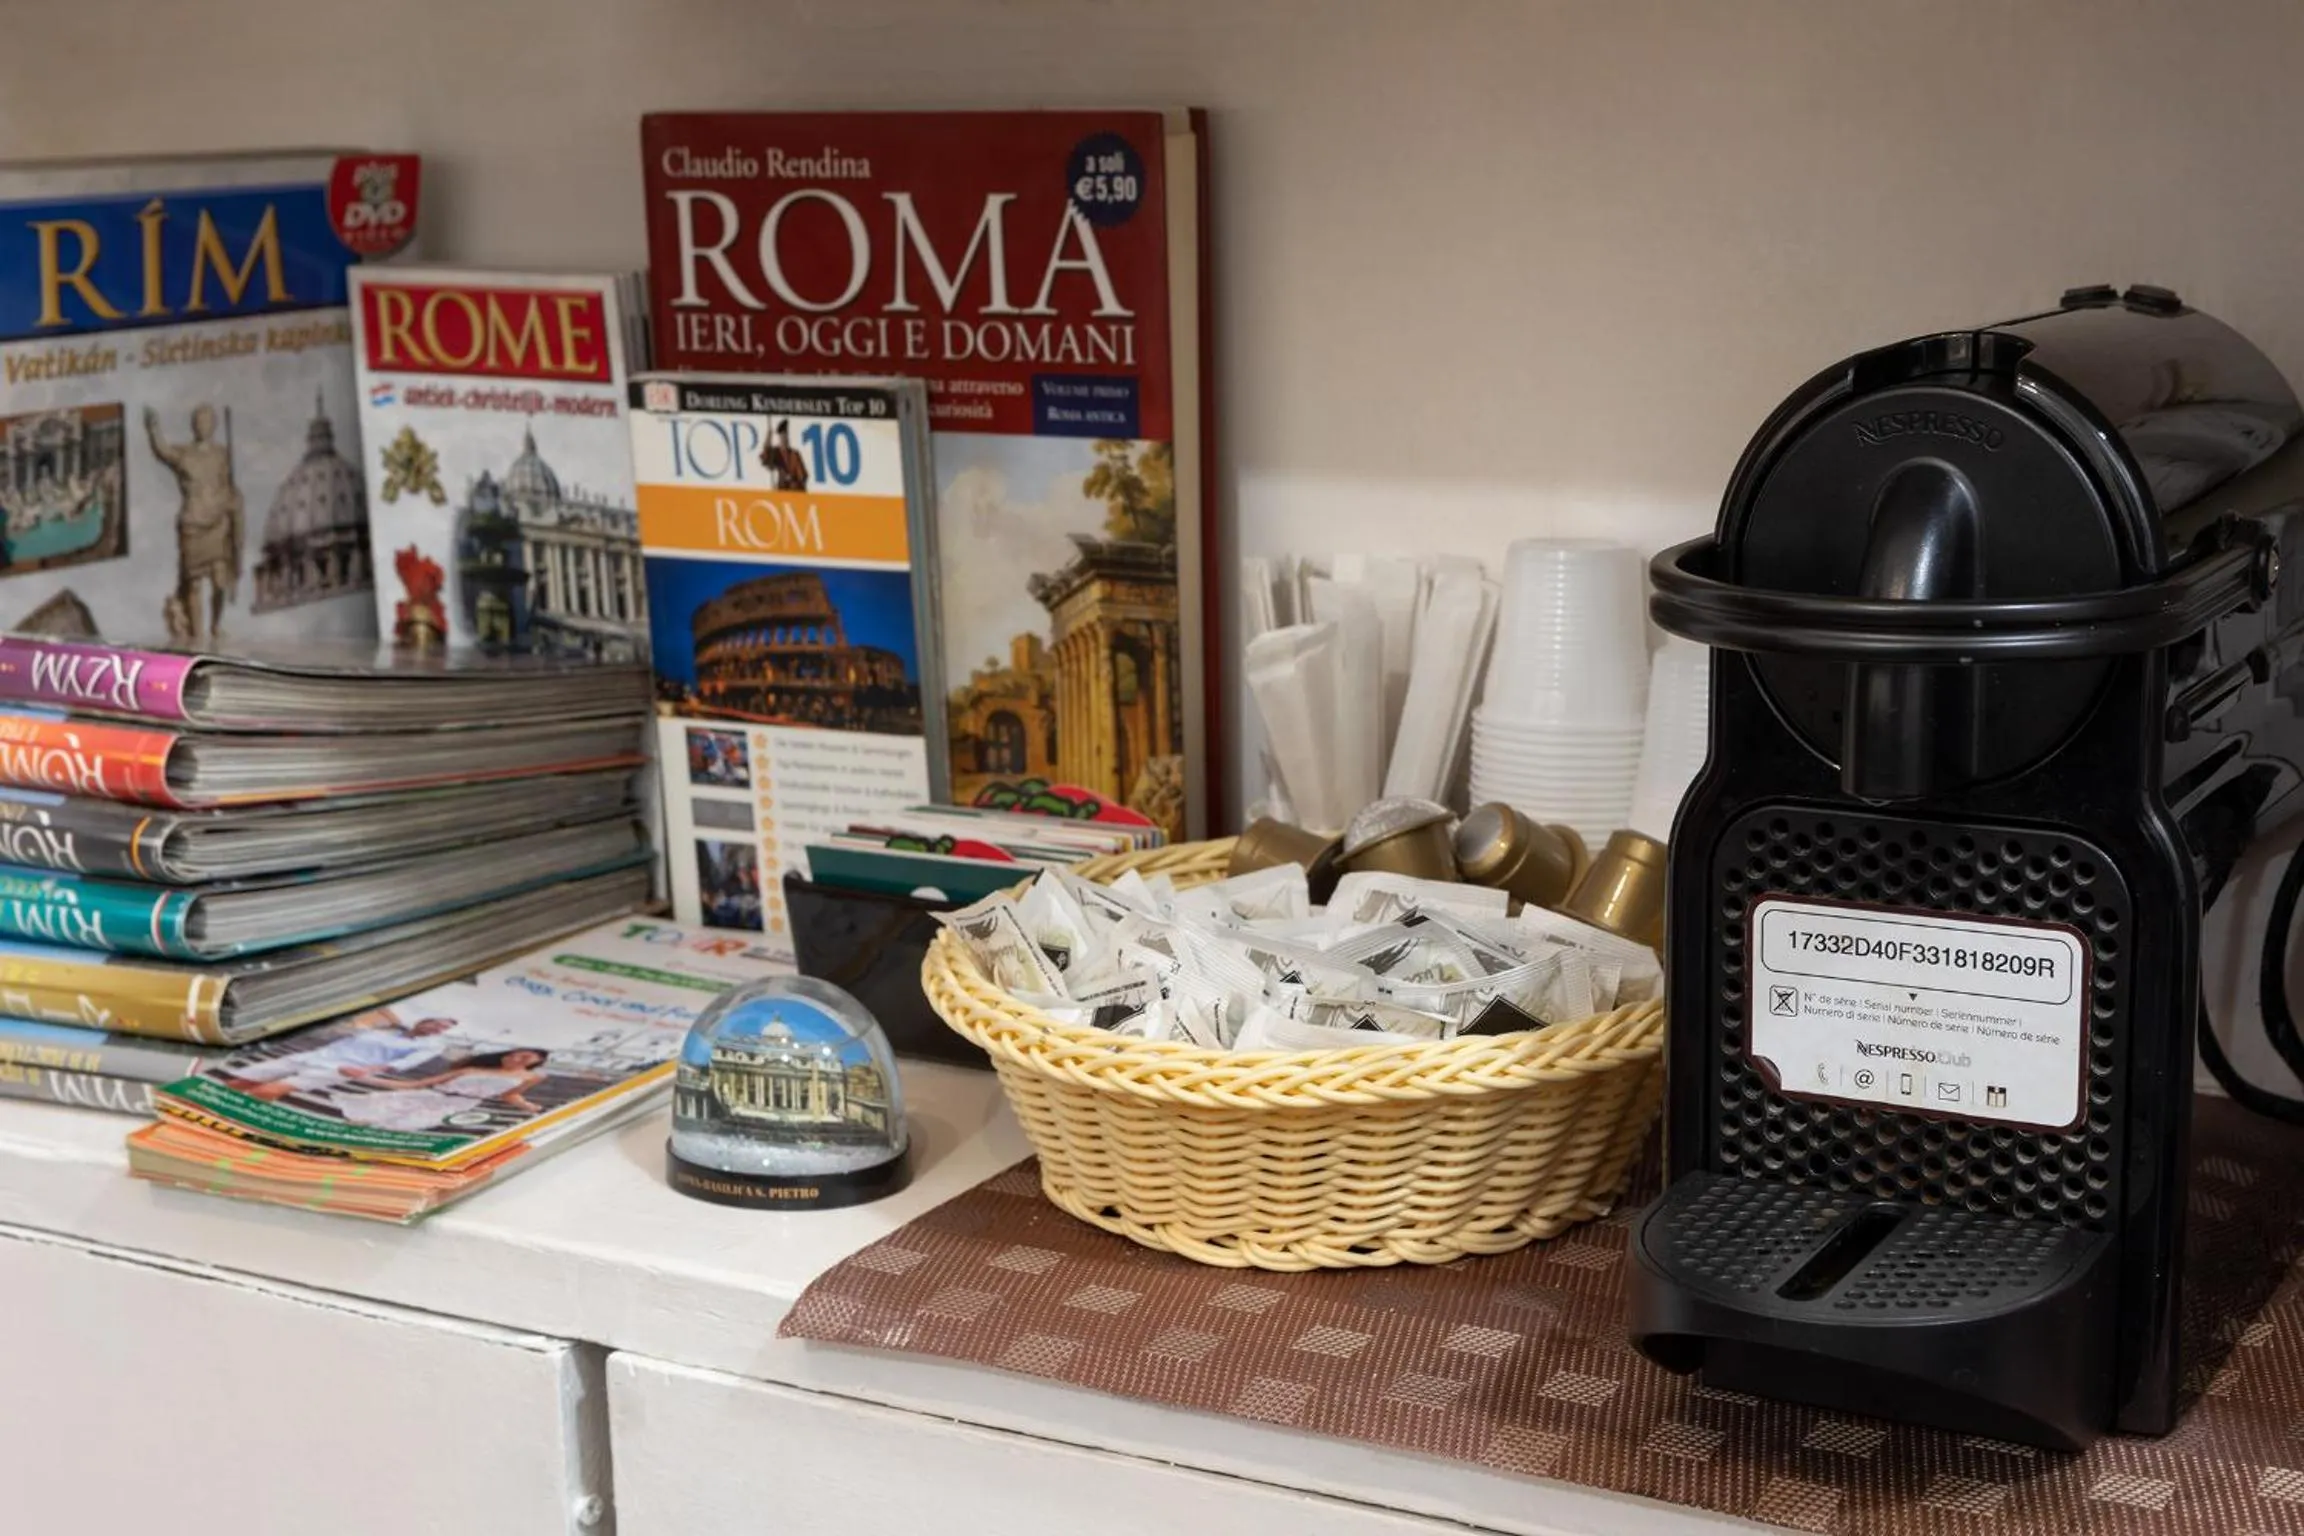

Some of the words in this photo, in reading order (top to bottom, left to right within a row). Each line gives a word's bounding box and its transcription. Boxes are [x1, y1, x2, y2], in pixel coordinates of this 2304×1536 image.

[661, 146, 759, 179] Claudio
[766, 147, 871, 180] Rendina
[343, 200, 407, 229] DVD
[26, 197, 295, 328] RÍM
[664, 188, 1136, 317] ROMA
[375, 289, 599, 374] ROME
[675, 313, 765, 359] IERI,
[776, 315, 890, 358] OGGI
[904, 319, 930, 359] E
[942, 319, 1136, 366] DOMANI
[869, 399, 886, 416] 10
[1853, 411, 2005, 453] NESPRESSO
[657, 416, 758, 481] TOP
[801, 421, 862, 486] 10
[714, 497, 824, 552] ROM
[31, 650, 143, 711] RZYM
[1788, 930, 2056, 979] 17332D40F331818209R
[1894, 1003, 1933, 1017] number
[1941, 1008, 2016, 1026] Seriennummer
[769, 1187, 820, 1199] PIETRO
